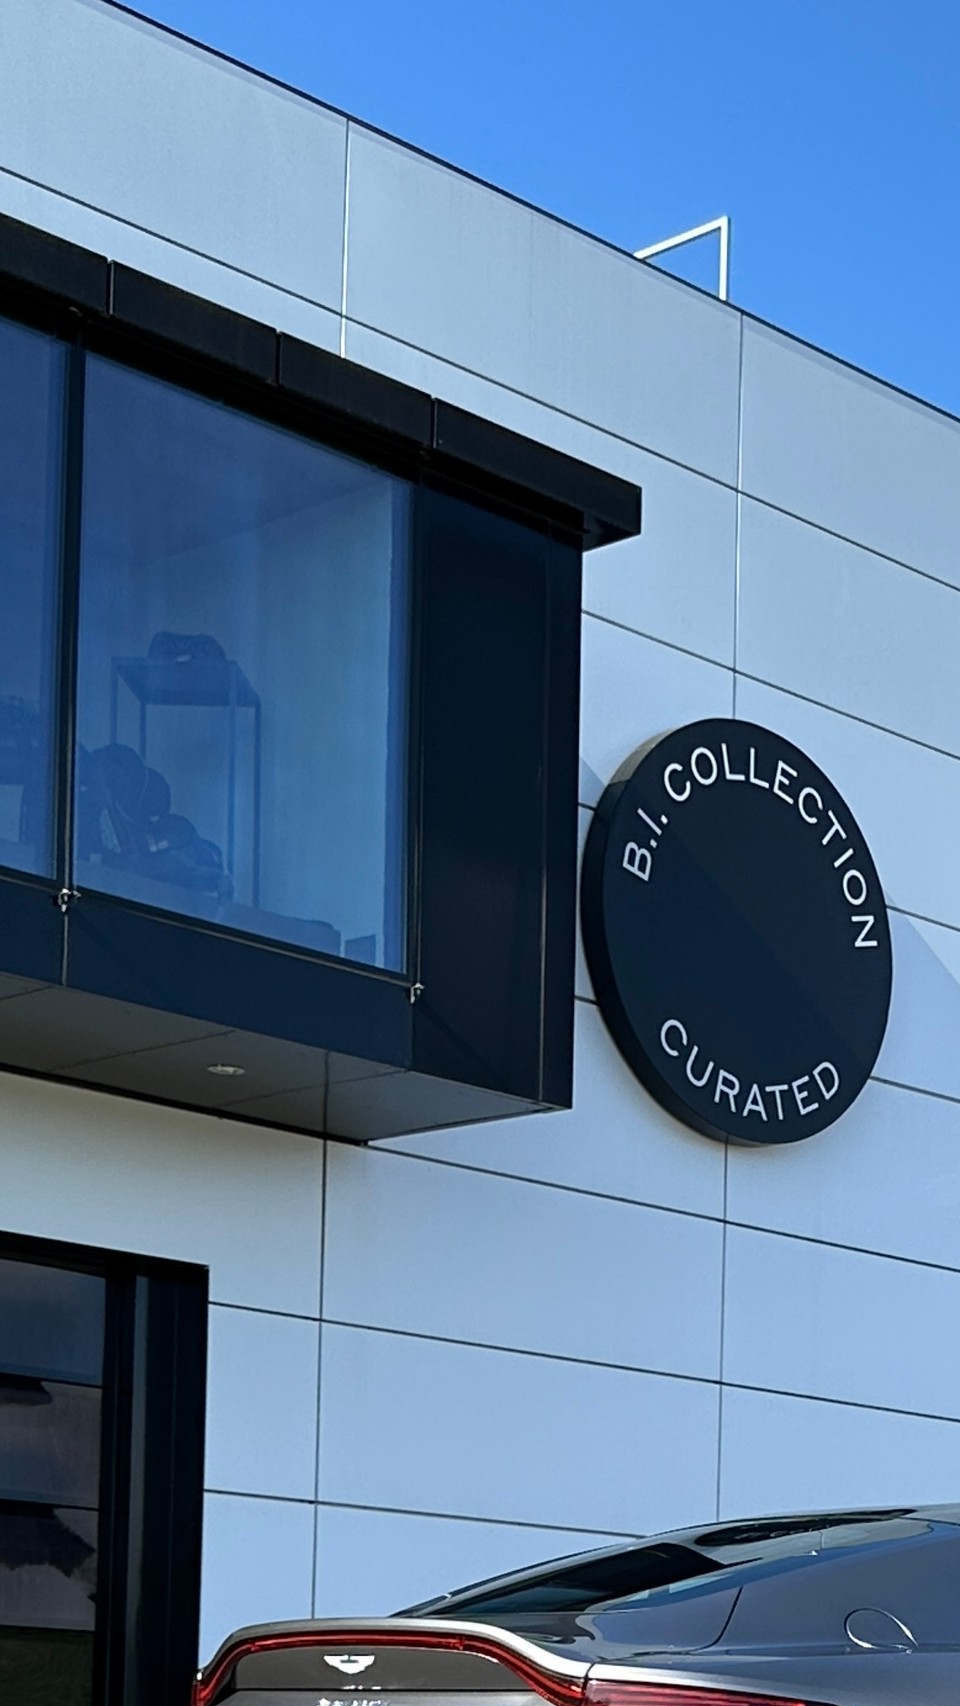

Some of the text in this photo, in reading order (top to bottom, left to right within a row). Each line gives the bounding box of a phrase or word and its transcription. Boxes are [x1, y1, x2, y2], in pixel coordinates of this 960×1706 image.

[622, 742, 878, 947] B.I. COLLECTION
[660, 1018, 840, 1121] CURATED
